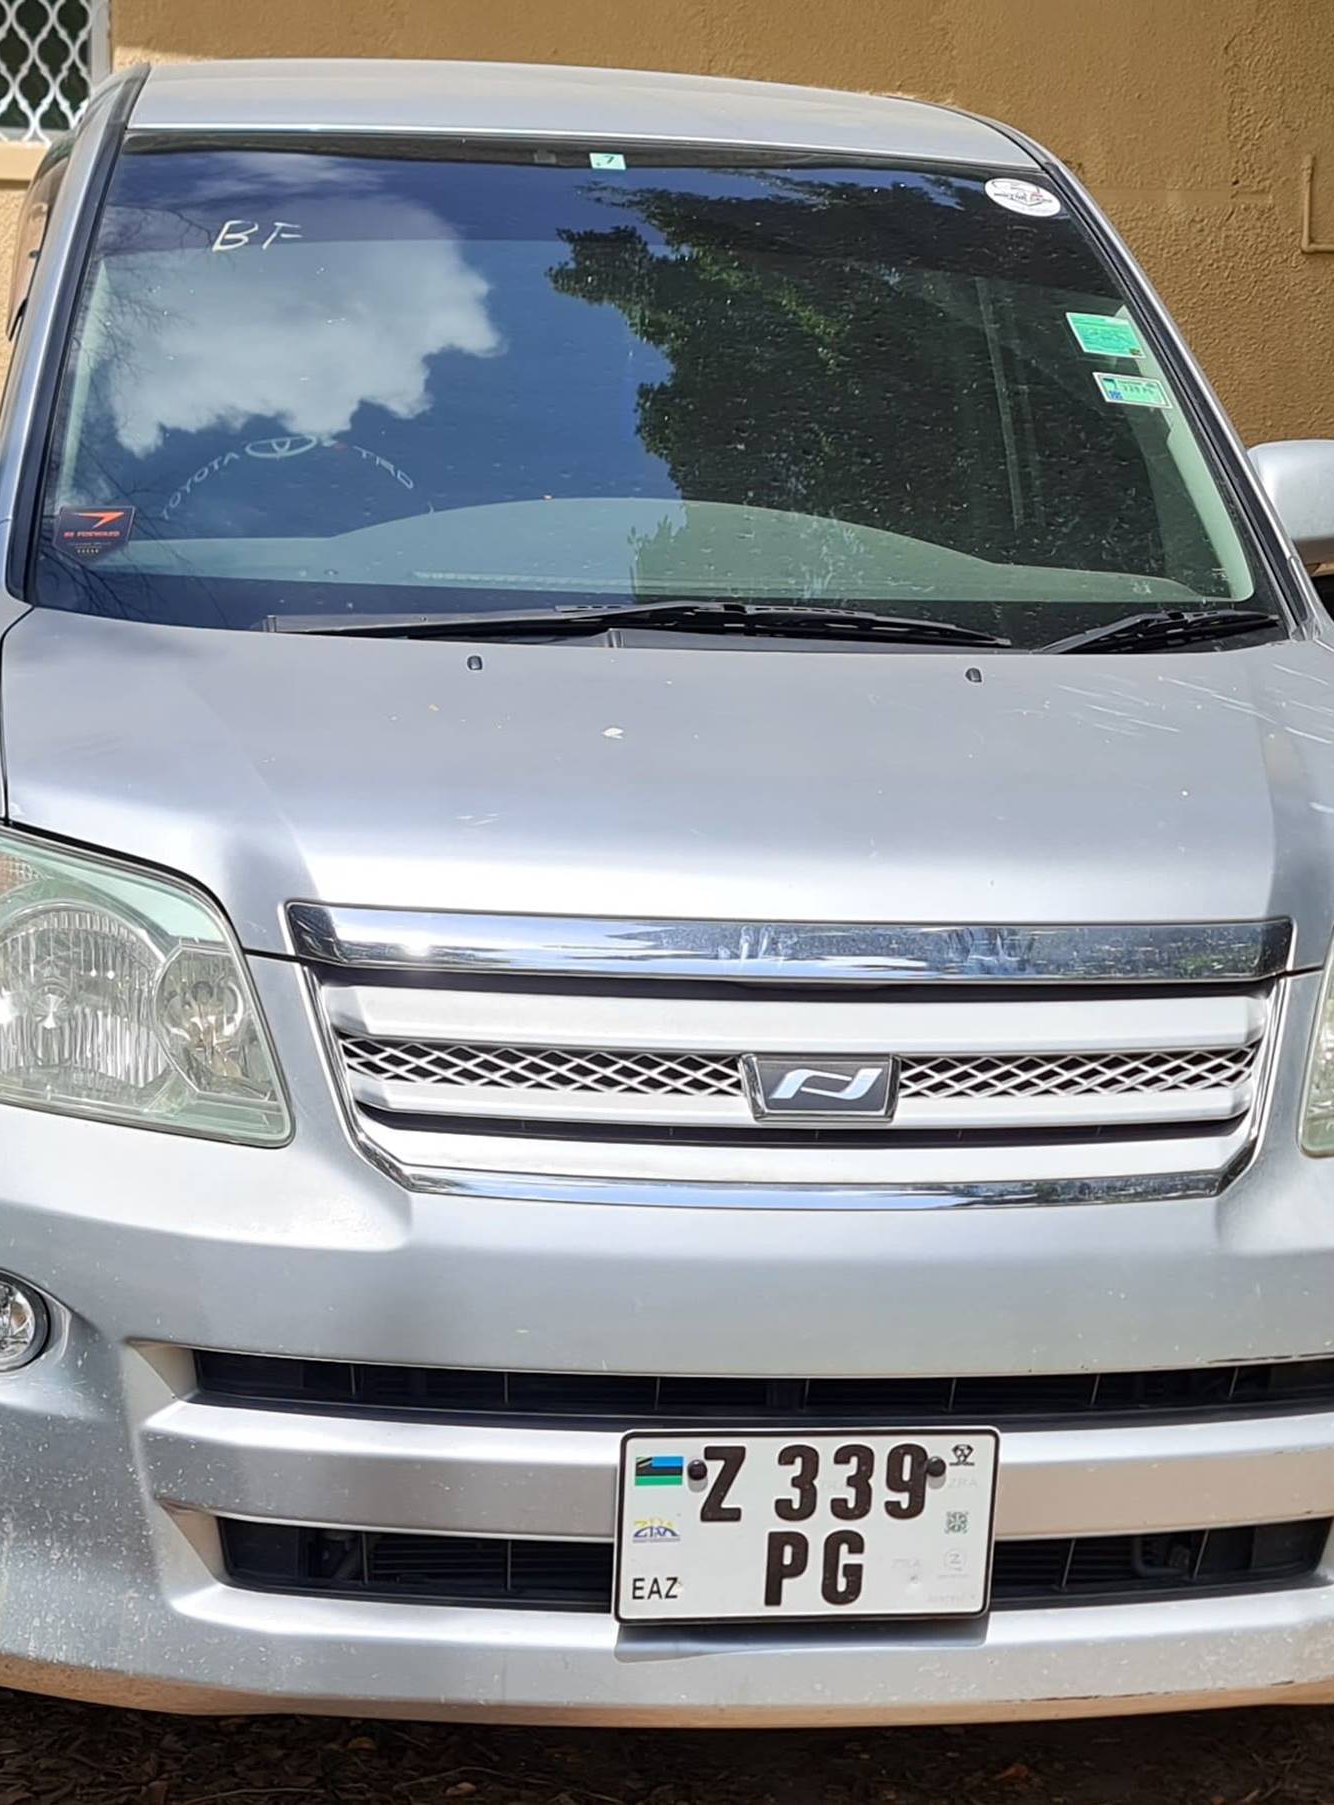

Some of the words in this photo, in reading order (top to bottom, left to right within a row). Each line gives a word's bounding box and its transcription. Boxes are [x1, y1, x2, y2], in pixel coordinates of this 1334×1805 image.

[161, 451, 241, 521] TOYOTA
[351, 444, 414, 490] TRD
[700, 1445, 747, 1522] Z
[774, 1443, 929, 1522] 339
[632, 1577, 679, 1600] EAZ
[764, 1530, 865, 1607] PG
